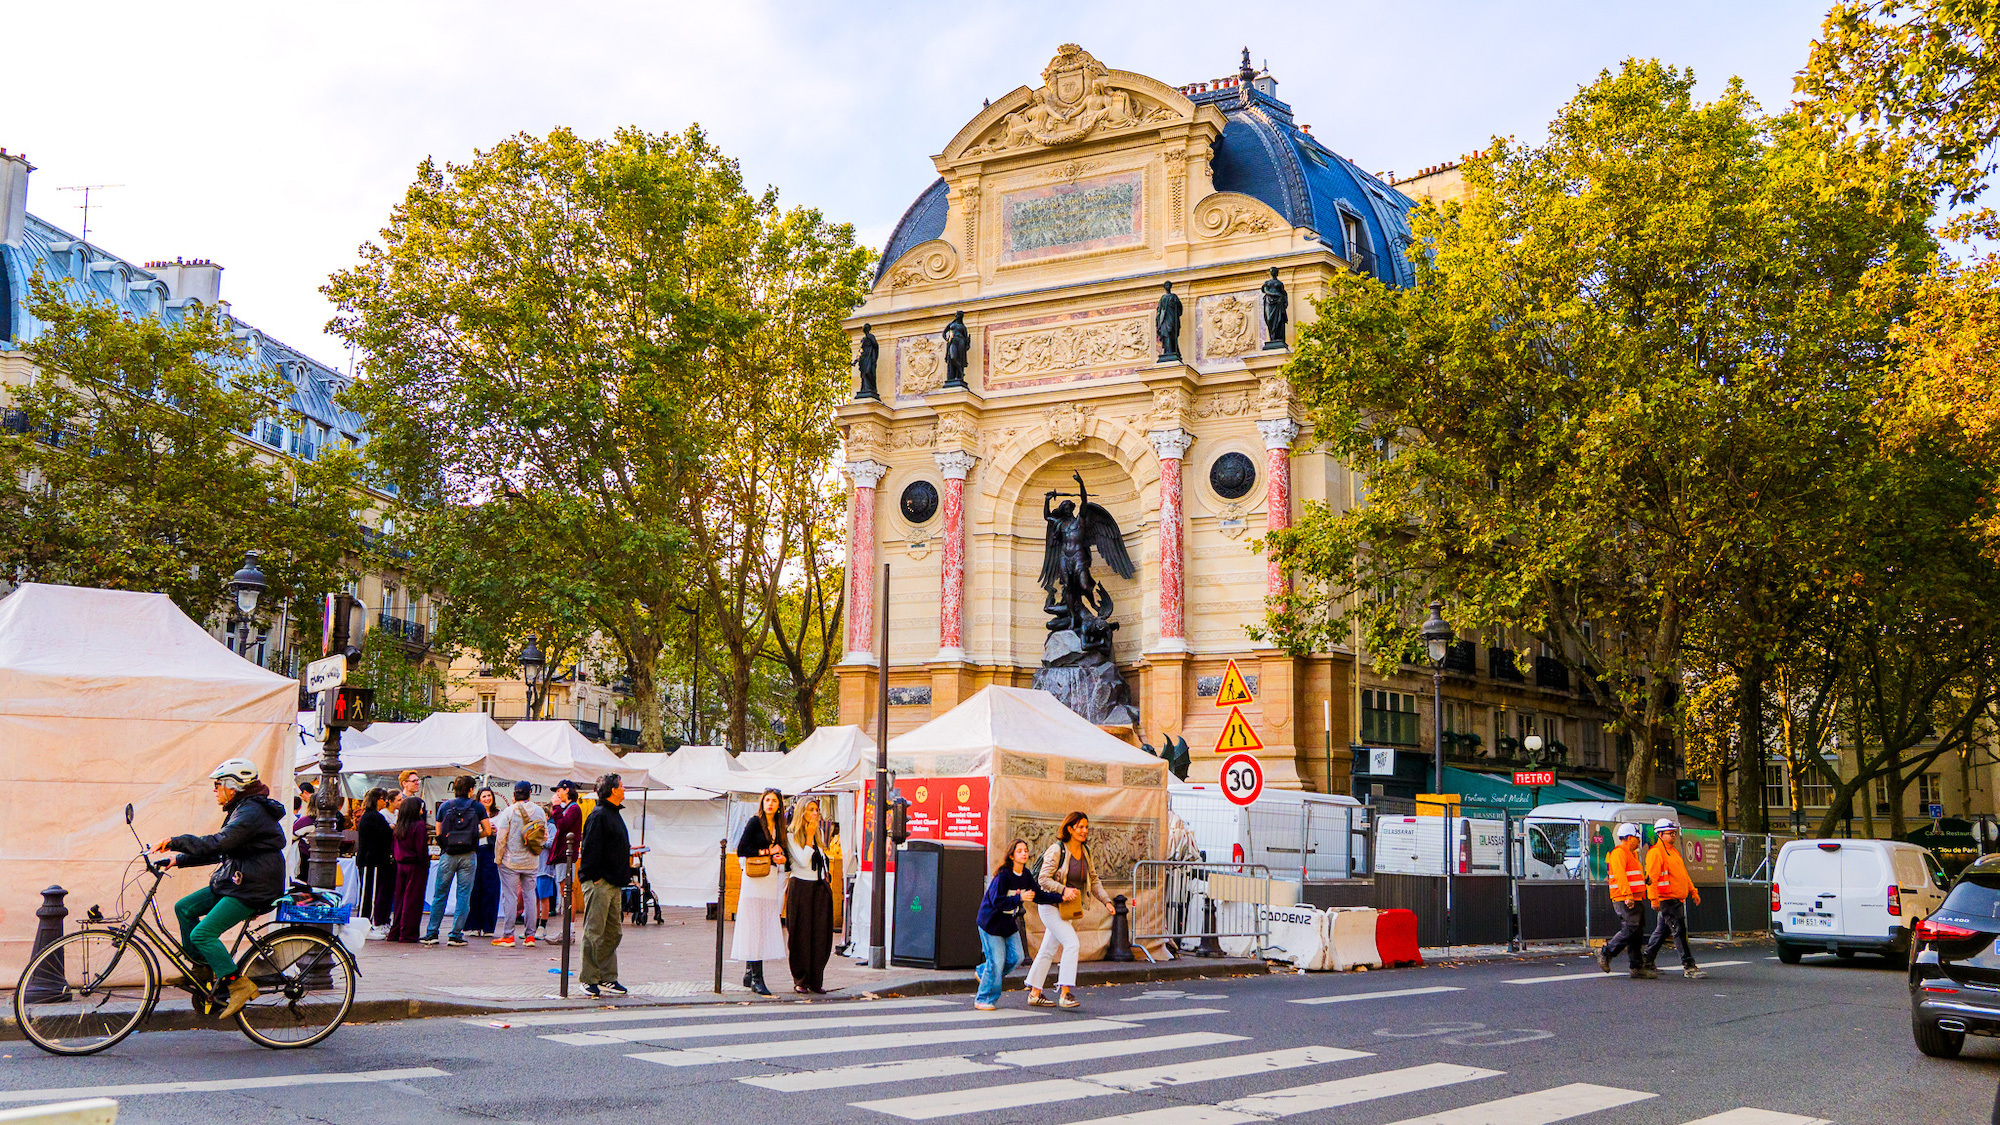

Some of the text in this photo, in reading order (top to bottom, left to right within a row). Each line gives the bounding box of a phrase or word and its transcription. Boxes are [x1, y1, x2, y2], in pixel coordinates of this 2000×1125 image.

[1228, 768, 1255, 792] 30
[1516, 773, 1551, 784] METRO
[917, 791, 926, 799] 7€
